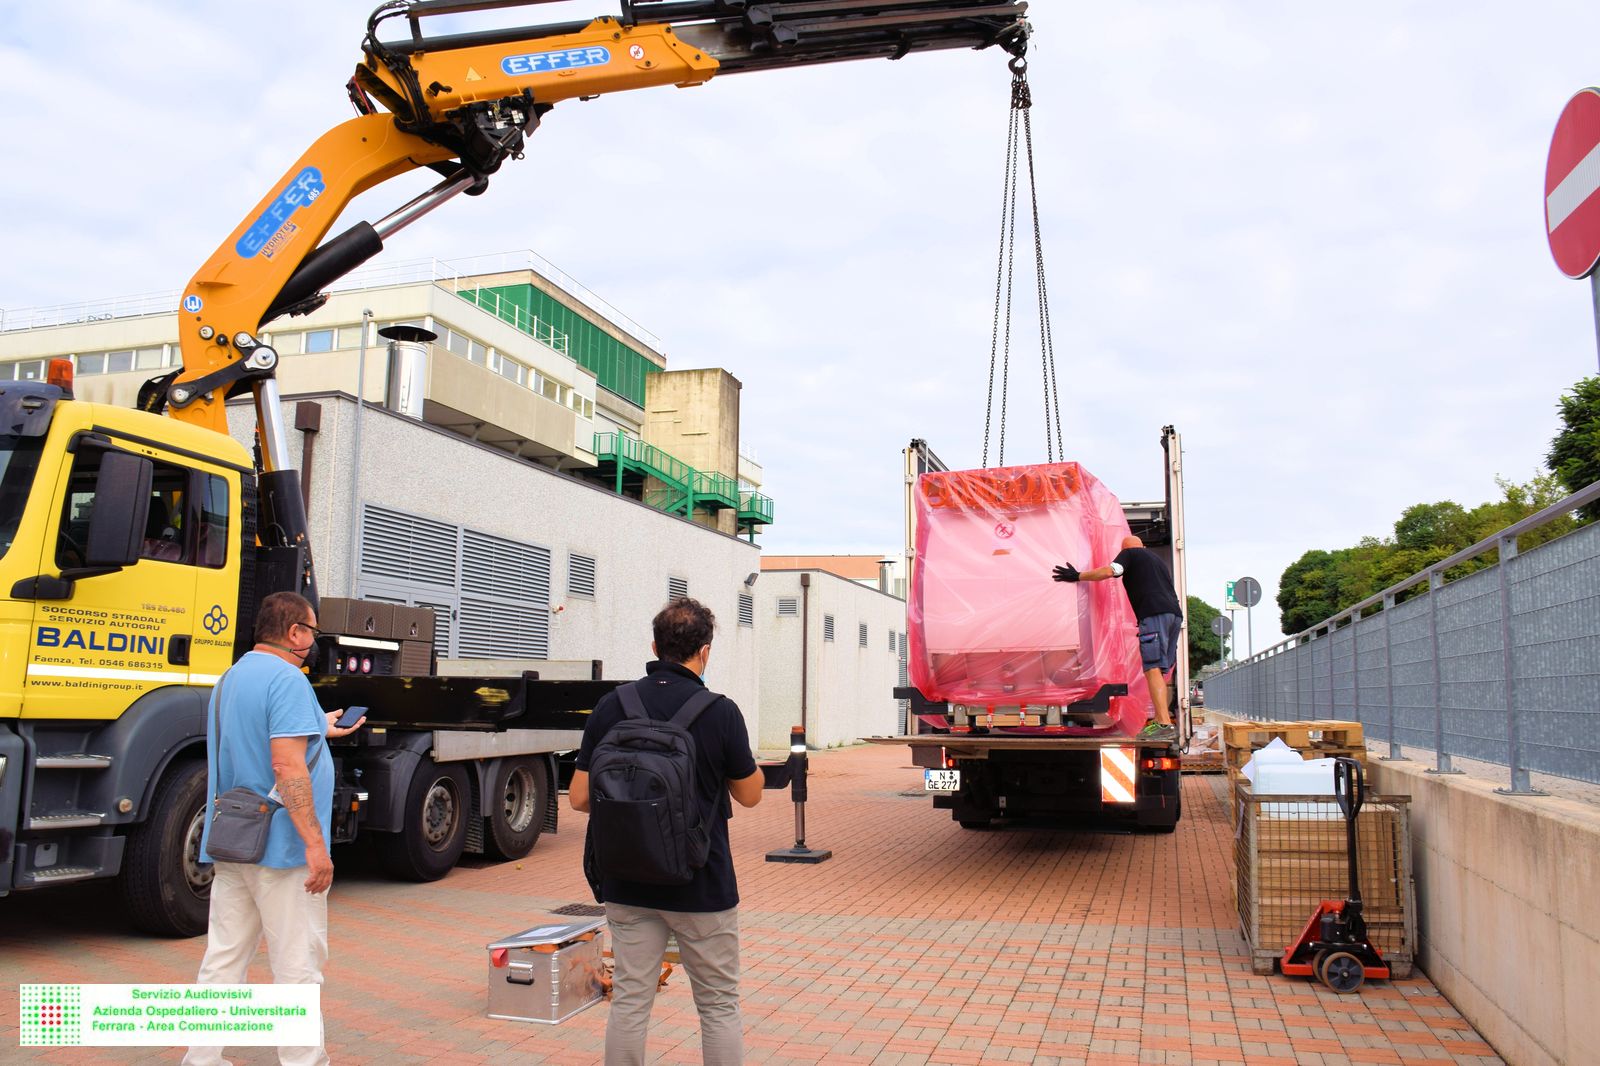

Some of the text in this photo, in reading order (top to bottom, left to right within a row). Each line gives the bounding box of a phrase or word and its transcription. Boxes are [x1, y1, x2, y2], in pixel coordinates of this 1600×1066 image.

[508, 48, 605, 73] EFFER
[242, 171, 319, 251] EFFER
[42, 606, 166, 624] SOCCORSO STRADALE
[49, 615, 160, 631] SERVIZIO AUTOGRU
[36, 626, 165, 655] BALDINI
[194, 638, 232, 648] GRUPPO BALDINI
[34, 655, 75, 665] Faenza,
[99, 659, 125, 667] 0546
[128, 661, 163, 669] 686315
[31, 680, 143, 691] www.baldinigroup.it
[940, 771, 946, 780] N
[928, 780, 939, 790] GE
